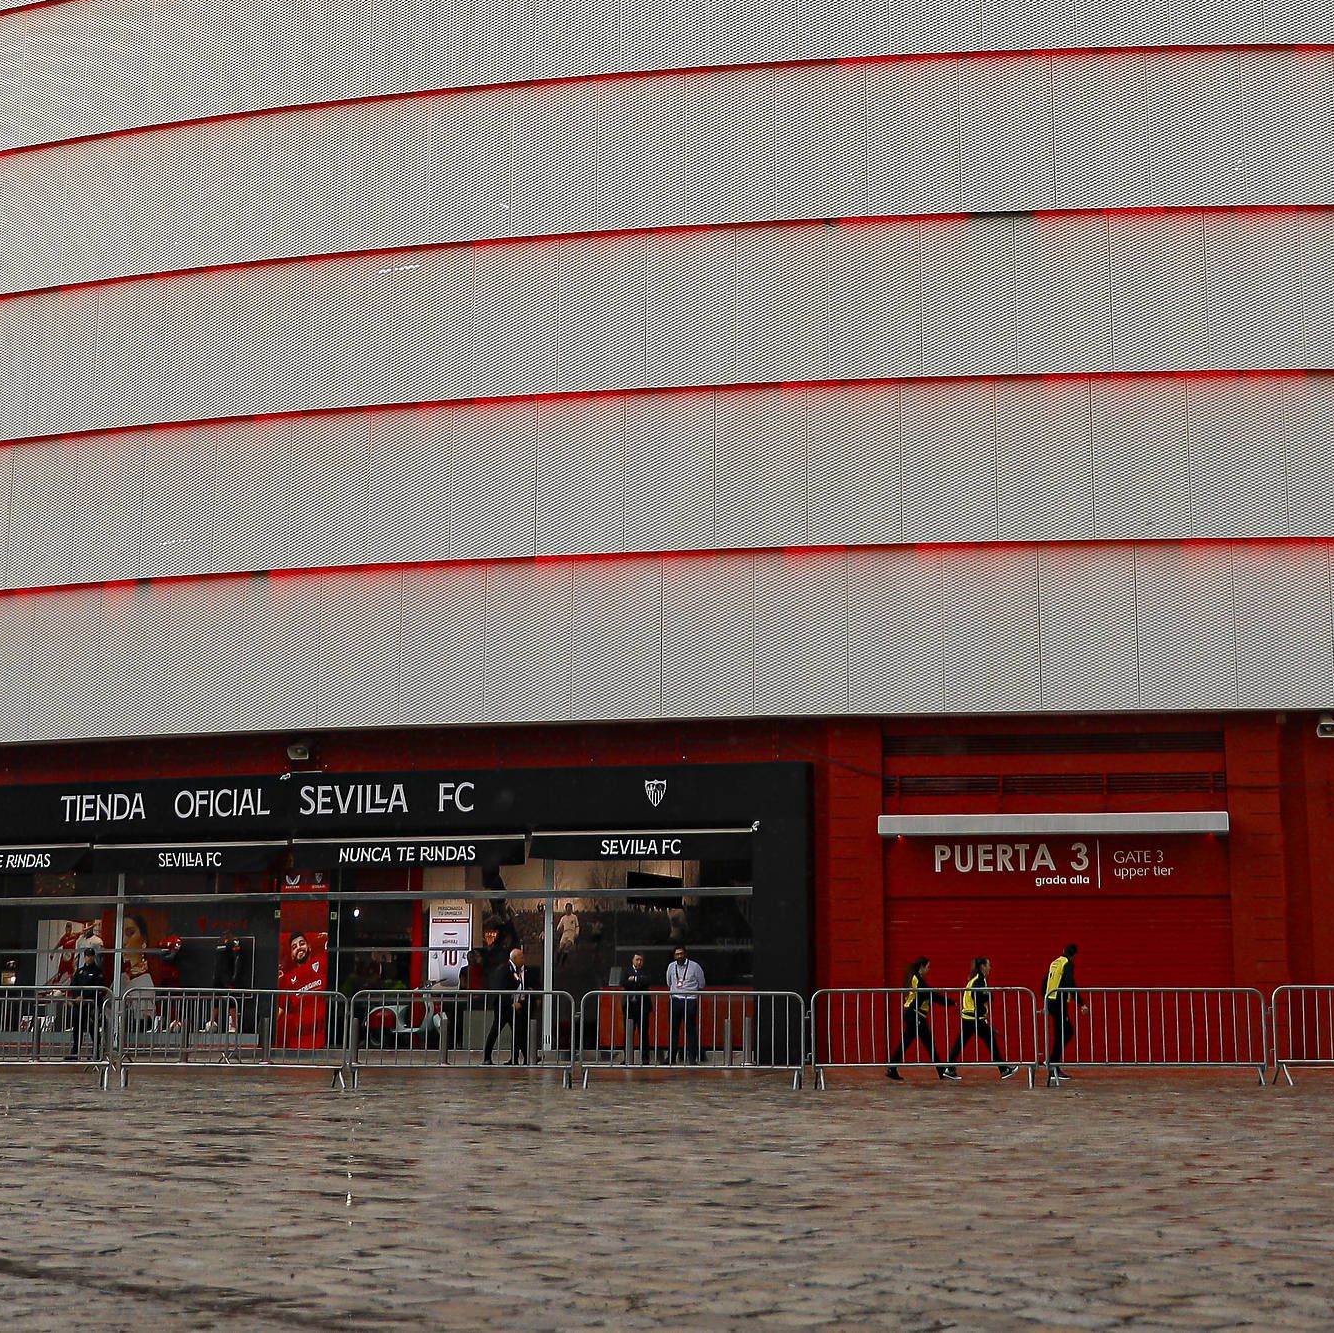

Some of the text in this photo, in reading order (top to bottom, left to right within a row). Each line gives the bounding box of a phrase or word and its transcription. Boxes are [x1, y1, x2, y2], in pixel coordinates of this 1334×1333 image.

[61, 782, 475, 822] TIENDA OFICIAL SEVILLA FC
[339, 845, 476, 863] NUNCA TE RINDAS
[600, 839, 682, 855] SEVILLA FC
[6, 853, 51, 868] RINDAS
[158, 852, 222, 867] SEVILLA FC
[934, 842, 1089, 873] PUERTA 3
[1113, 849, 1164, 864] GATE 3
[1114, 866, 1174, 879] upper tier
[1035, 875, 1066, 886] grada
[442, 949, 459, 966] 10
